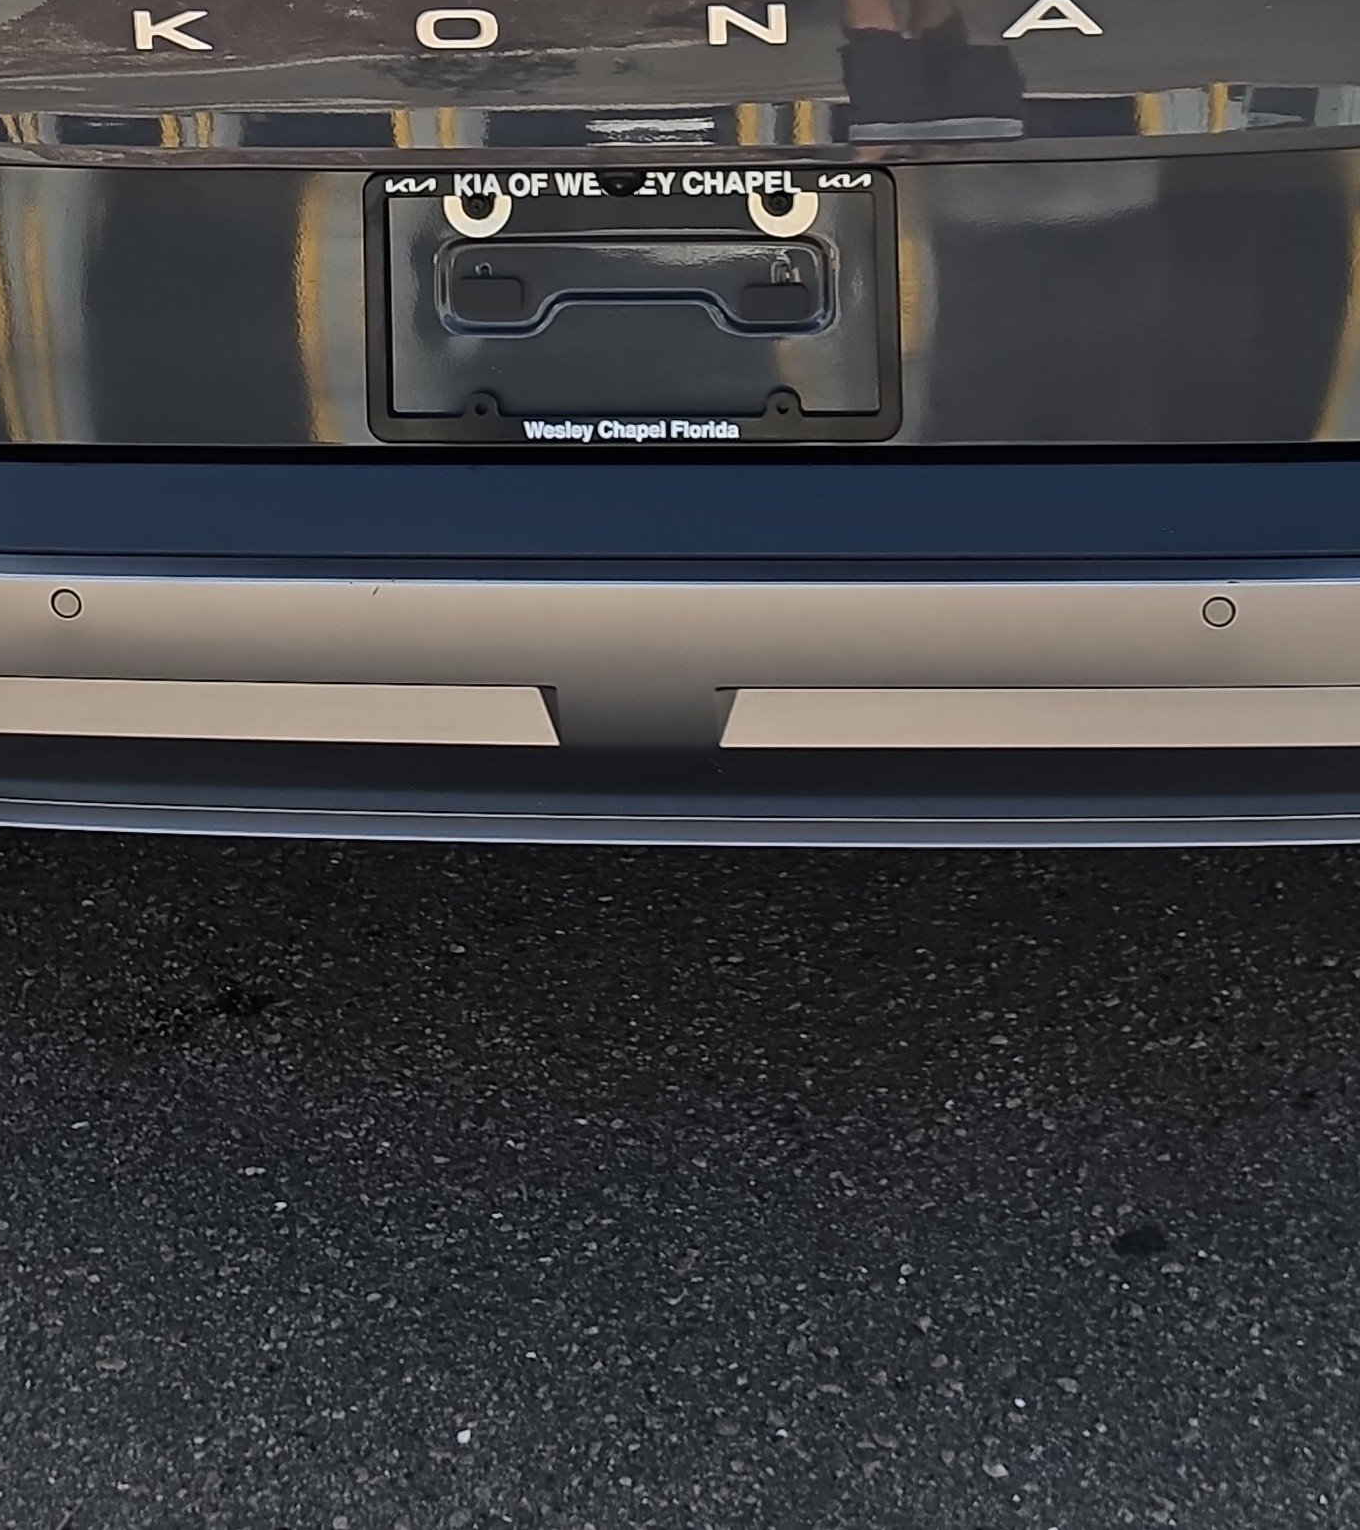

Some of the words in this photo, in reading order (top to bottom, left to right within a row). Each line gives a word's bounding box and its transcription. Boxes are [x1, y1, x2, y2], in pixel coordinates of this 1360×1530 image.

[453, 172, 503, 197] KIA
[508, 172, 548, 197] OF
[554, 171, 676, 196] WEEY
[682, 170, 802, 195] CHAPEL
[523, 421, 594, 443] Wesley
[597, 420, 667, 443] Chapel
[670, 421, 740, 439] Florida
